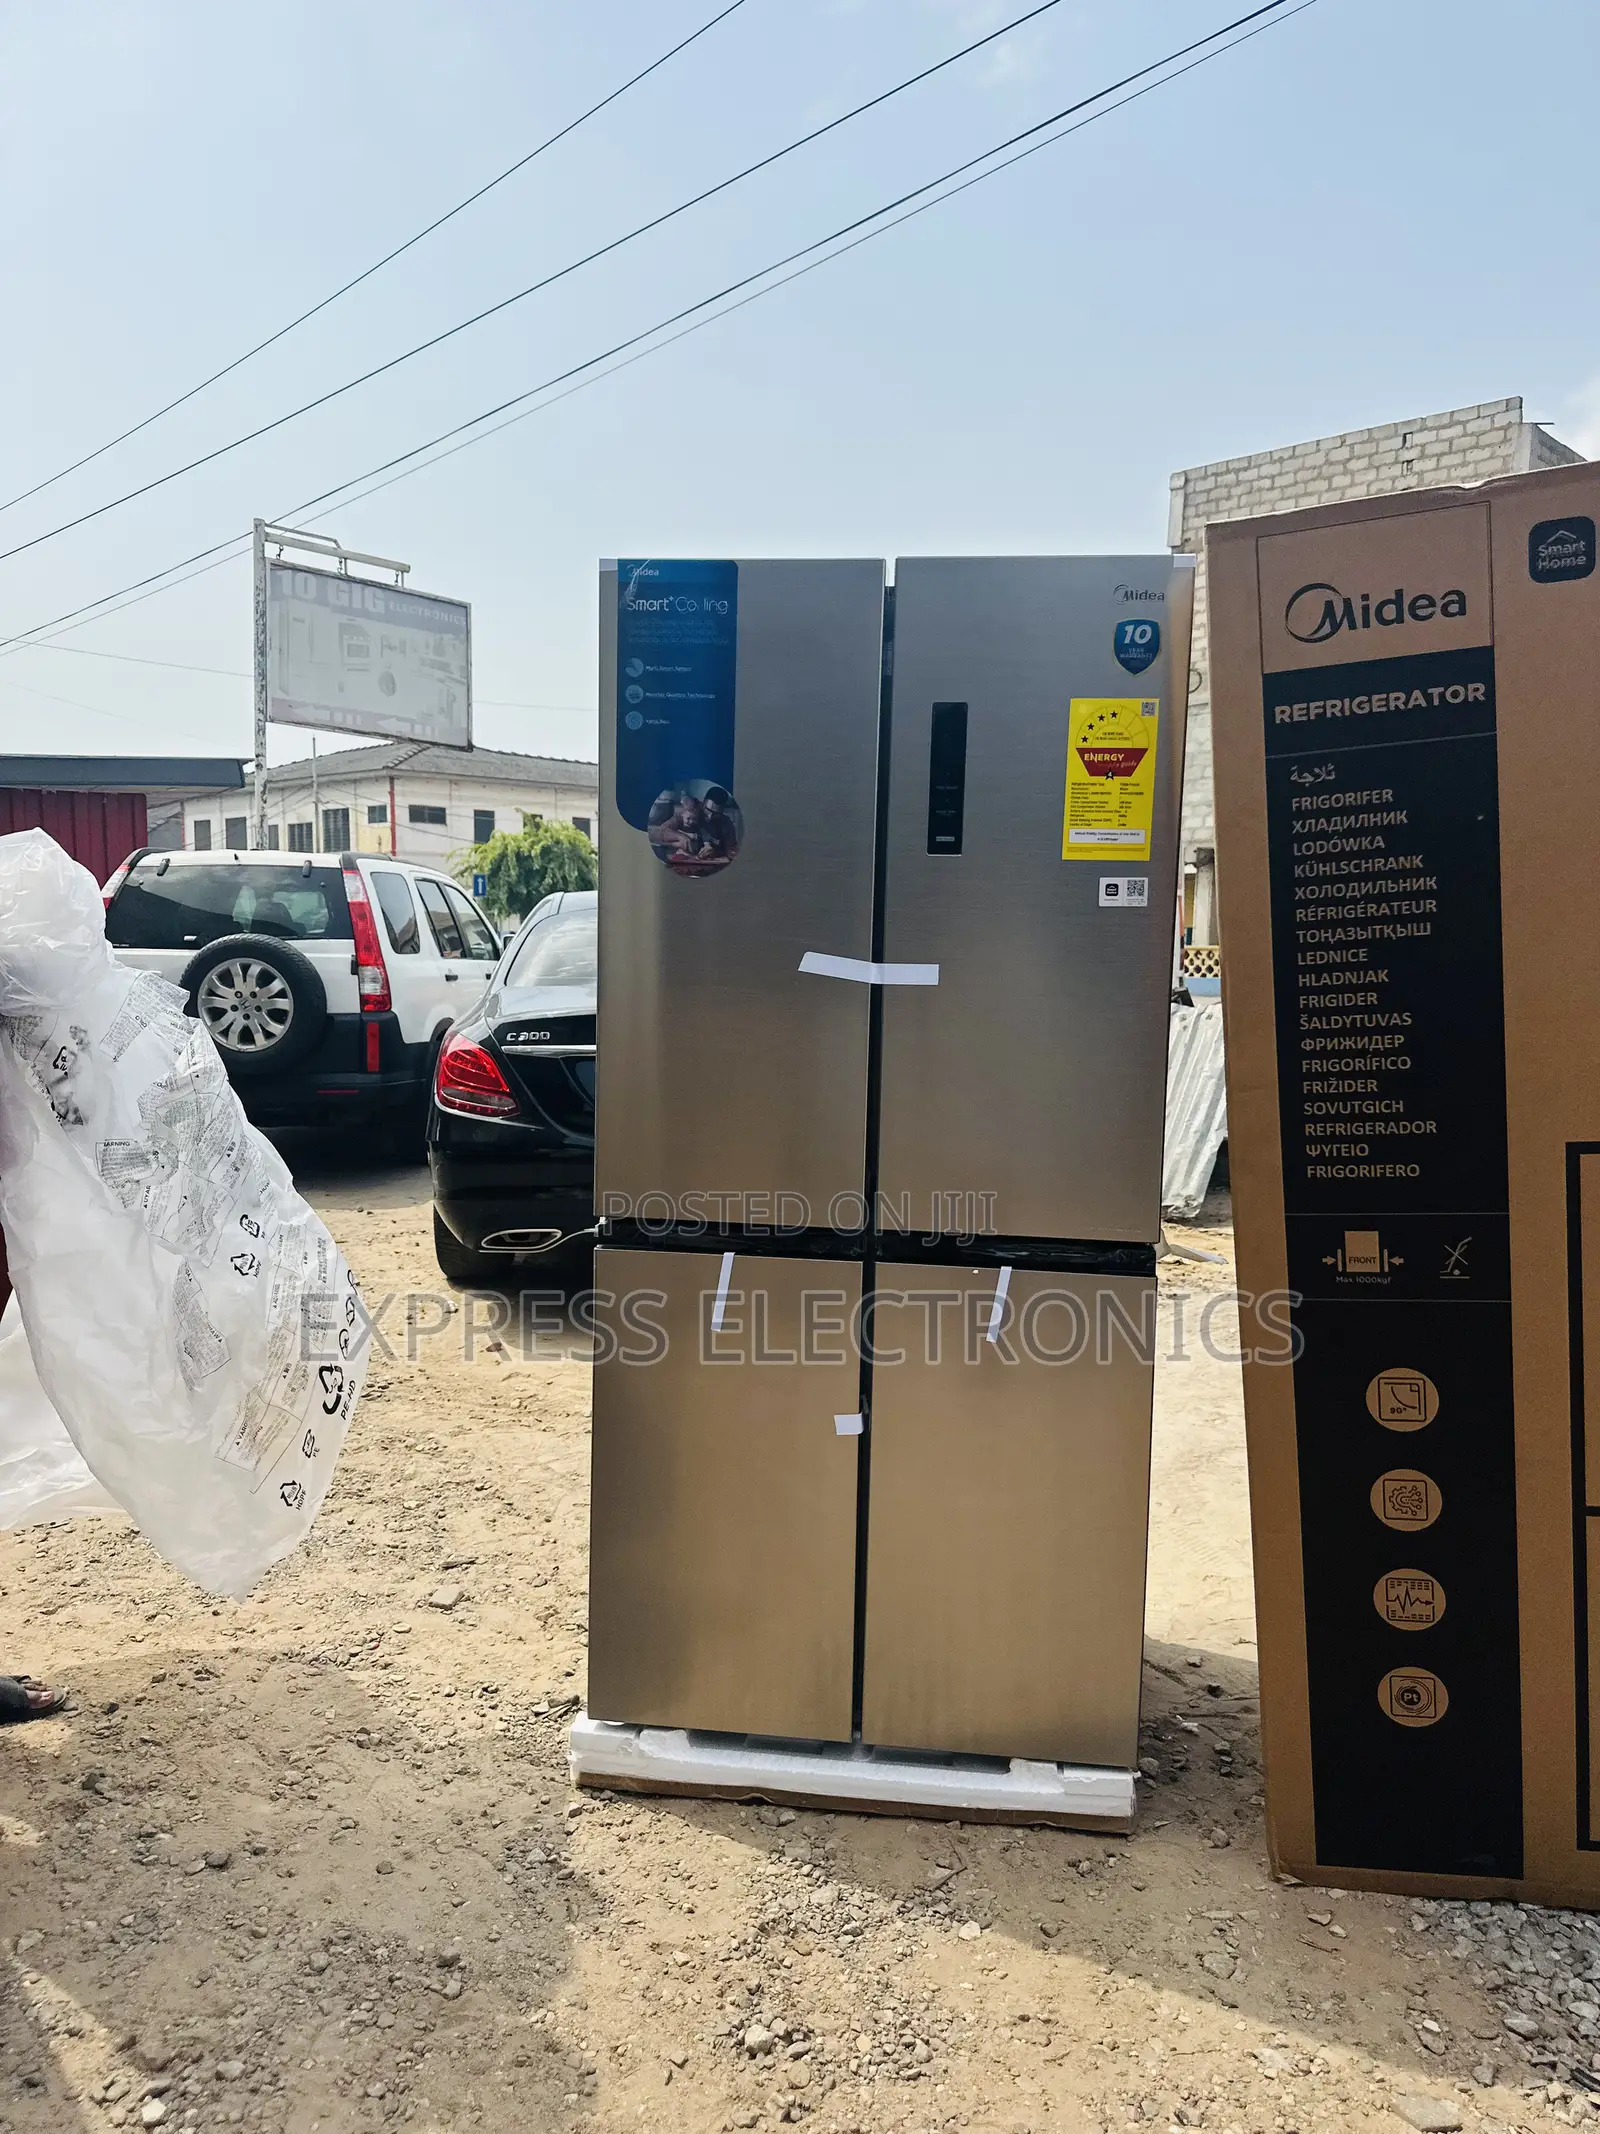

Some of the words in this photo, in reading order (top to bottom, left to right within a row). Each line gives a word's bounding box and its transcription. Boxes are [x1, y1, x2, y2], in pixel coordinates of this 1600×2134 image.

[1537, 540, 1586, 557] Smart
[1537, 554, 1586, 570] Home
[327, 577, 386, 614] GIG
[388, 602, 467, 625] ELECTRONICS
[1113, 584, 1165, 605] Midea
[1285, 582, 1467, 643] Midea
[1124, 624, 1152, 644] 10
[1274, 683, 1486, 724] REFRIGERATOR
[1084, 752, 1125, 763] ENERGY
[1292, 789, 1394, 811] FRIGORIFER
[1292, 810, 1409, 834] ХЛАДИЛНИК
[1293, 836, 1385, 856] LODÓWKA
[1294, 855, 1424, 878] KÜHLSCHRANK
[1294, 876, 1438, 900] ХОЛОДИЛЬНИК
[1296, 900, 1438, 922] RÉFRIGÉRATEUR
[1296, 922, 1431, 944] ТОҢАЗЫТҚЫШ
[1297, 949, 1368, 965] LEDNICE
[1298, 969, 1389, 987] HLADNJAK
[1299, 992, 1378, 1008] FRIGIDER
[1299, 1012, 1413, 1030] ŠALDYTUVAS
[1301, 1035, 1405, 1051] ФРИЖИДЕР
[1302, 1055, 1411, 1073] FRIGORÍFICO
[1303, 1077, 1378, 1094] FRIŽIDER
[1304, 1100, 1404, 1115] SOVUTGICH
[1305, 1121, 1438, 1136] REFRIGERADOR
[1306, 1143, 1369, 1157] ΨΥΓΕΙΟ
[1307, 1164, 1420, 1178] FRIGORIFERO
[1349, 1256, 1377, 1264] FRONT
[340, 1380, 356, 1420] PE-HD
[1404, 1692, 1419, 1703] Pt
